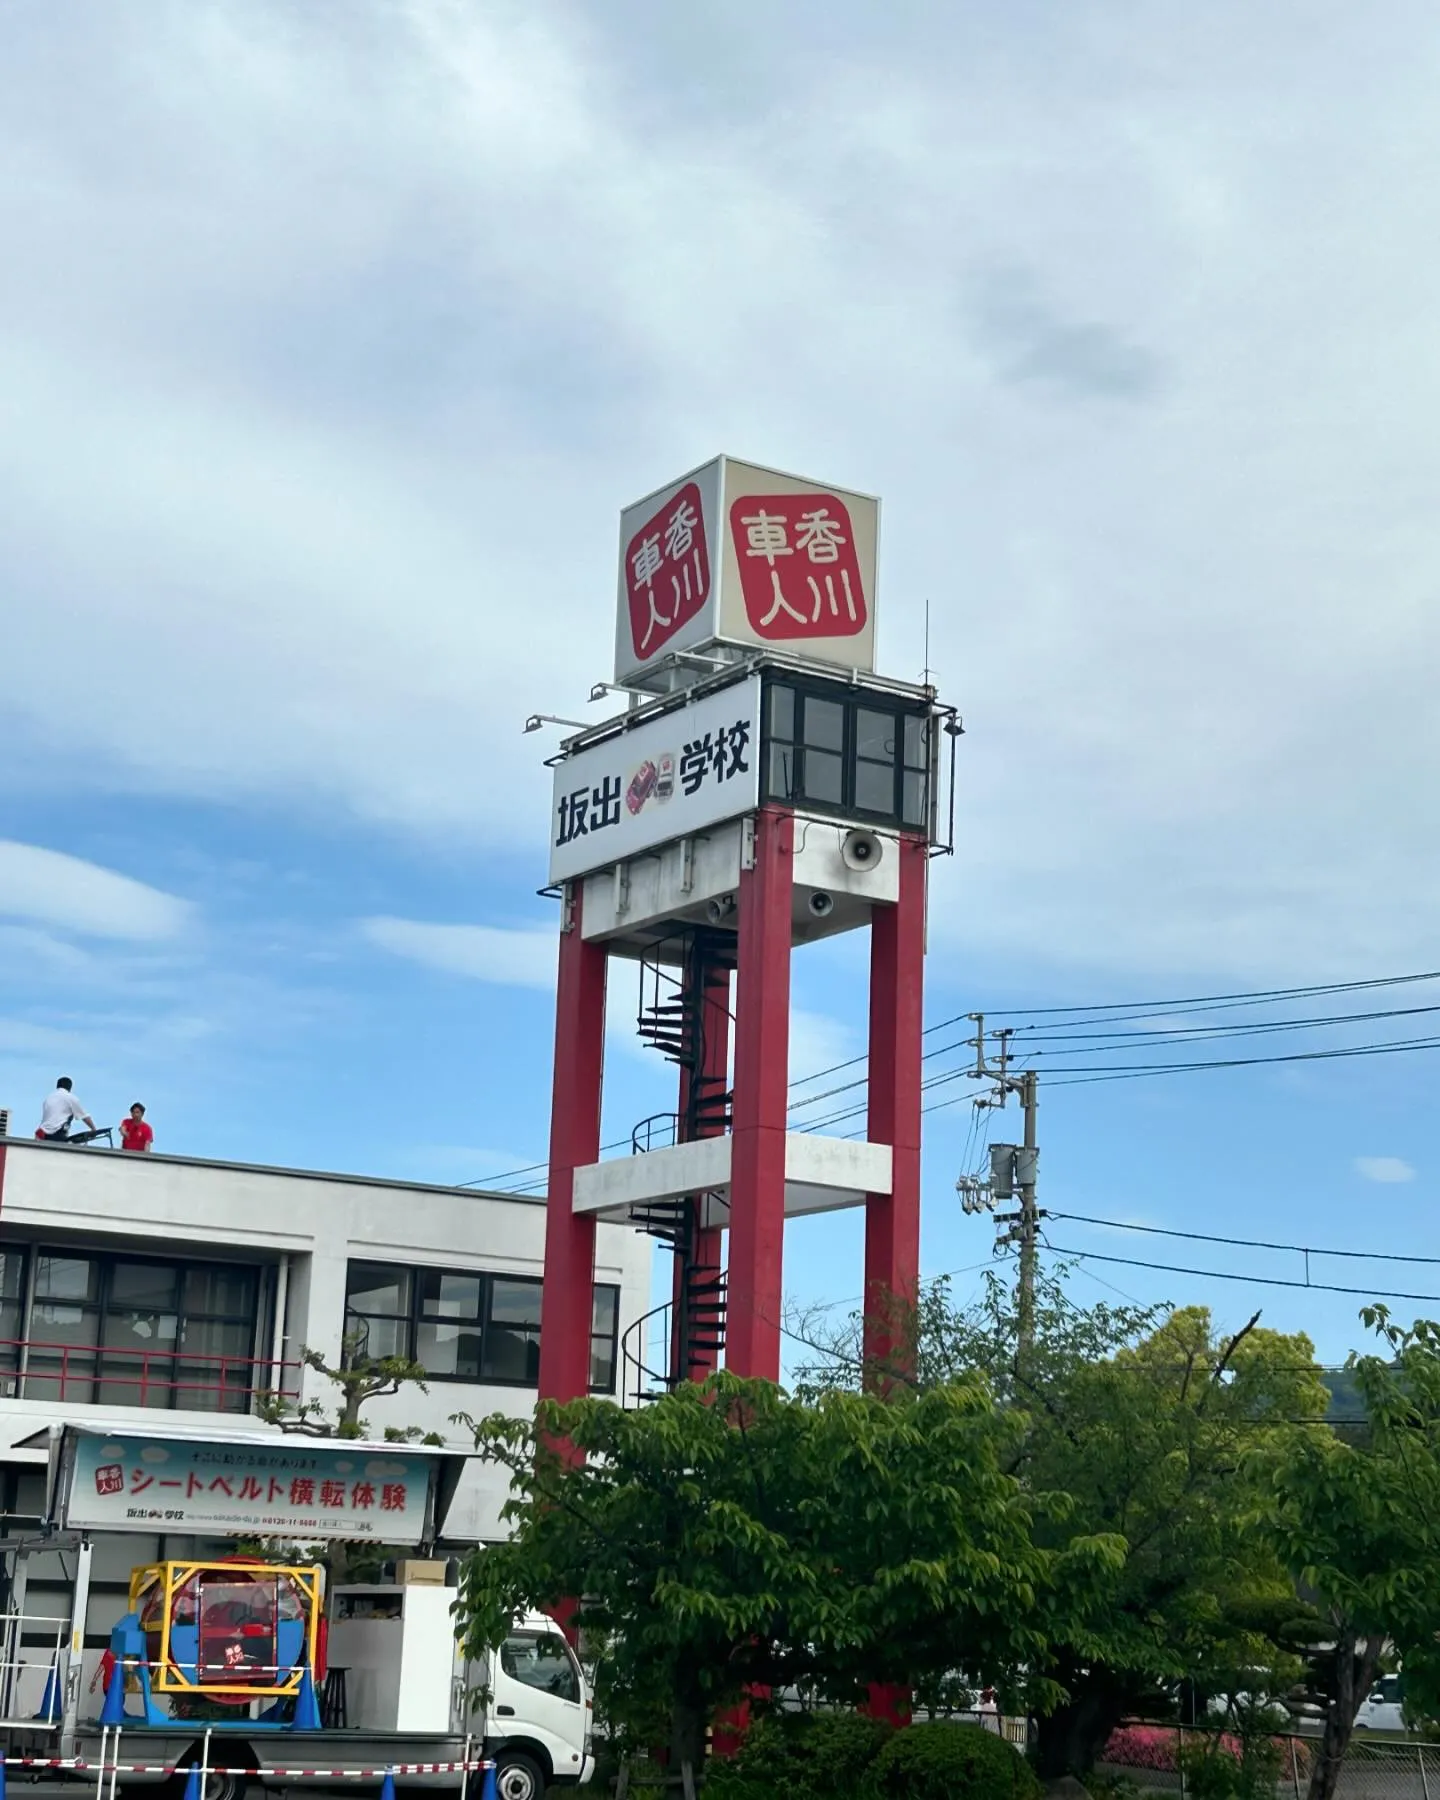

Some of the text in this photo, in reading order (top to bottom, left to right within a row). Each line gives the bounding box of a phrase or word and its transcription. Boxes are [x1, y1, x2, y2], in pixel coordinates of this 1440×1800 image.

[555, 719, 752, 848] 坂出 学校
[131, 1467, 408, 1512] シートベルト横転体験
